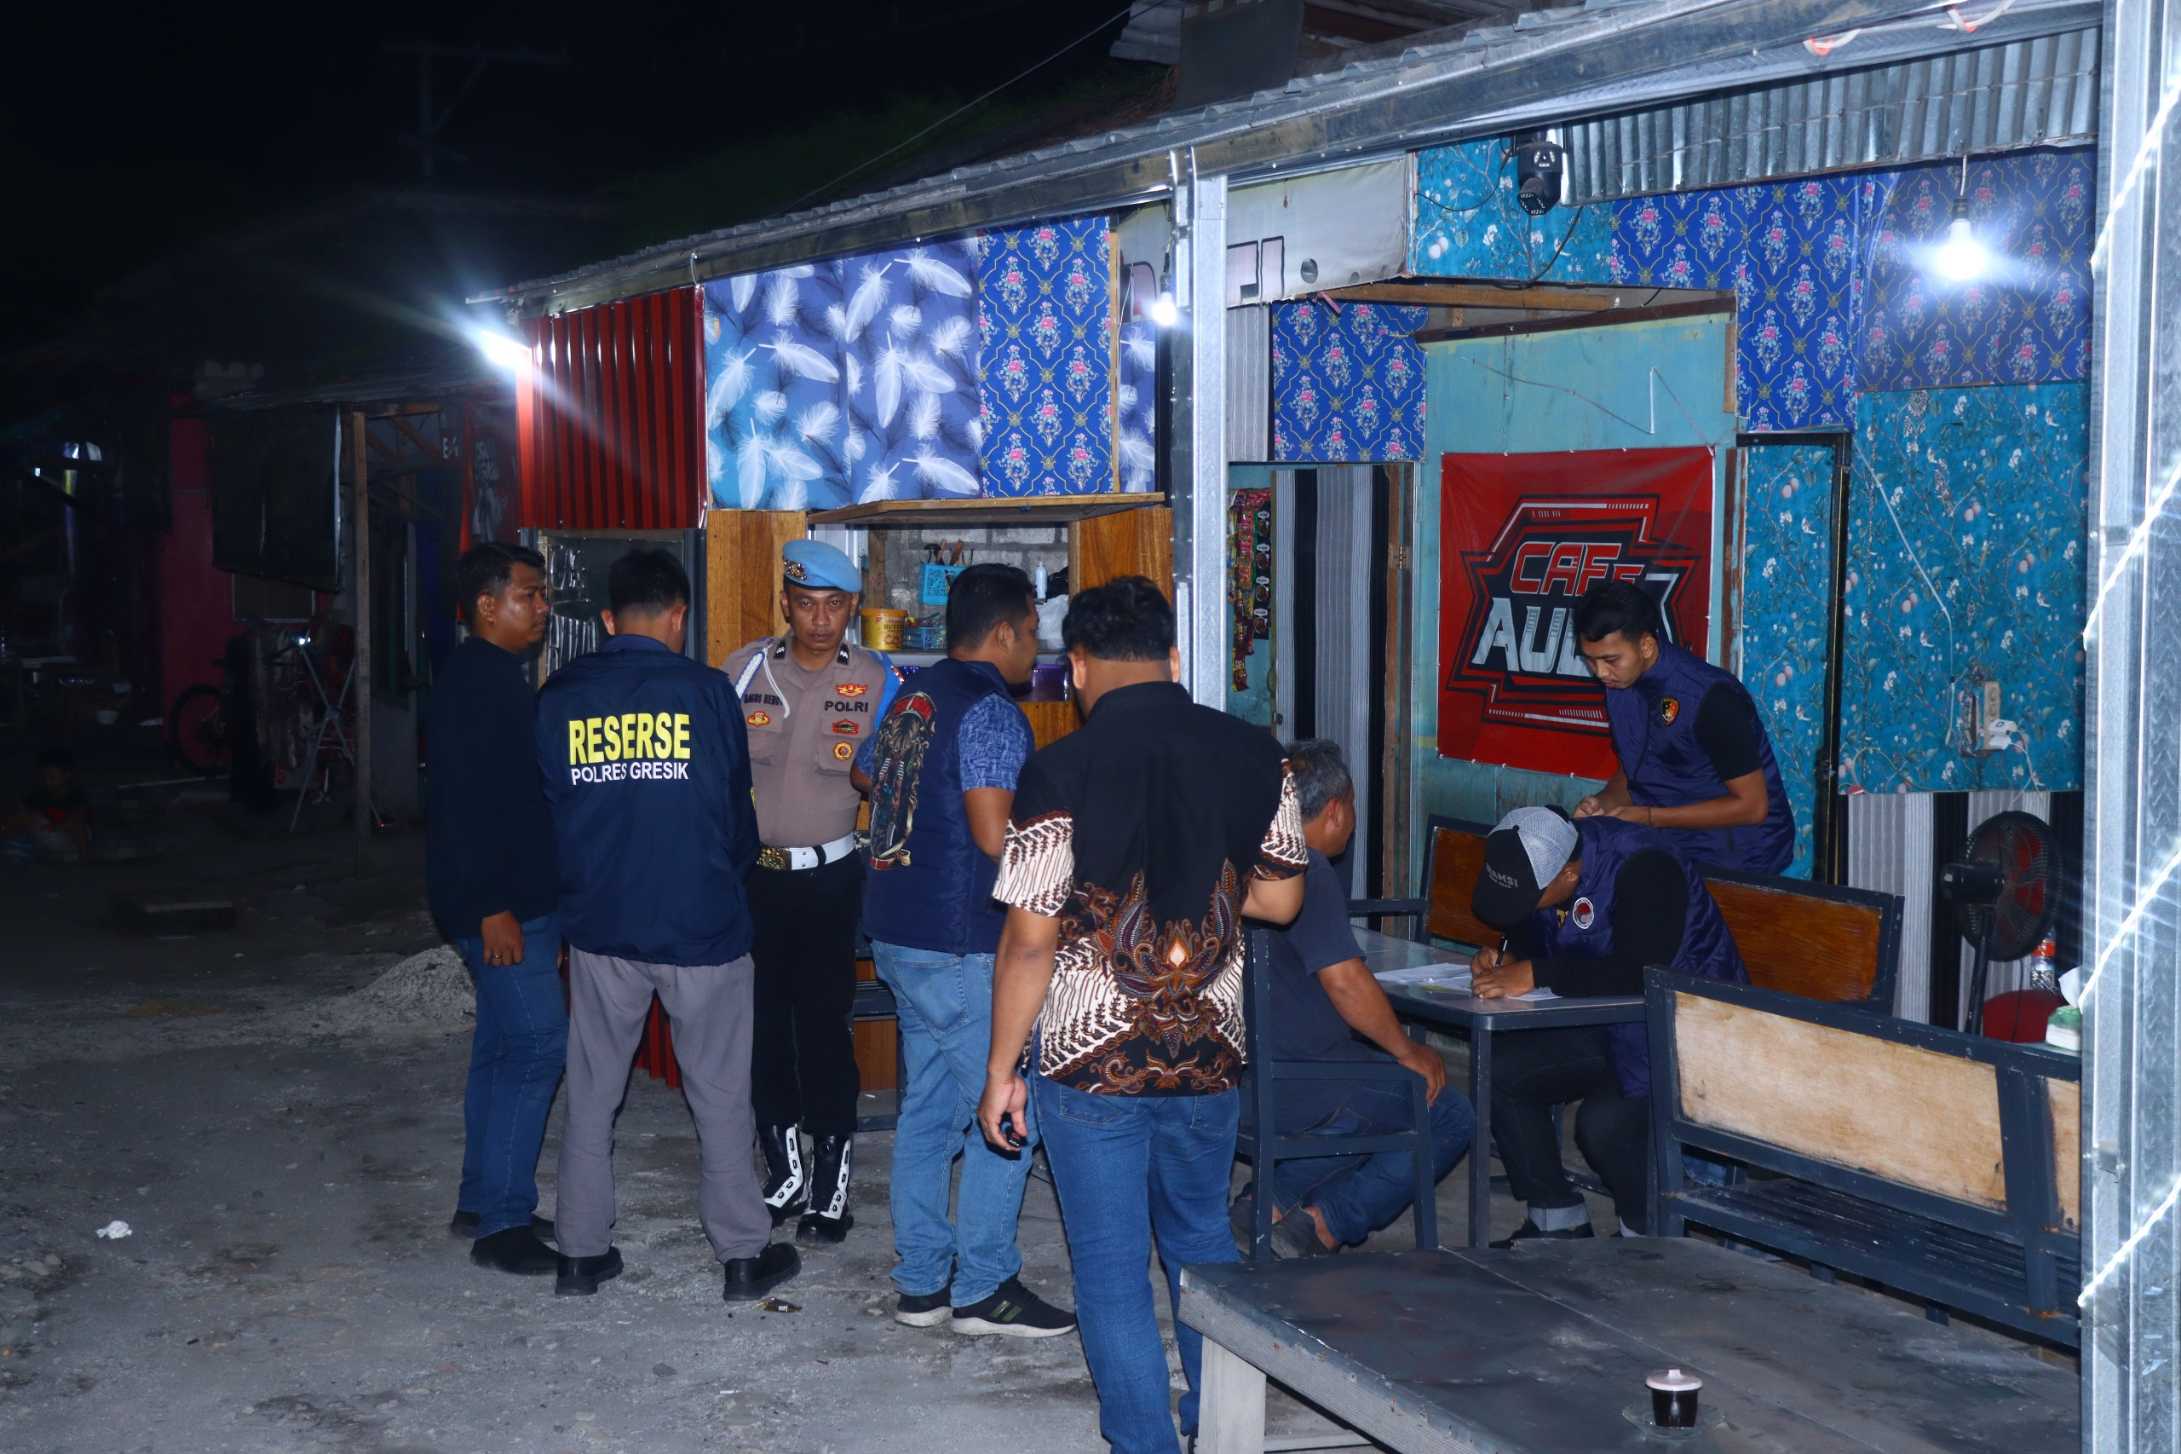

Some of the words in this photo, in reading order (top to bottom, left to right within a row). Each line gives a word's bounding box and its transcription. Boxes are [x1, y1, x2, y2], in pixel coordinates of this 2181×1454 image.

[824, 701, 869, 712] POLRI
[569, 712, 691, 765] RESERSE
[571, 763, 627, 785] POLRES
[630, 762, 688, 779] GRESIK
